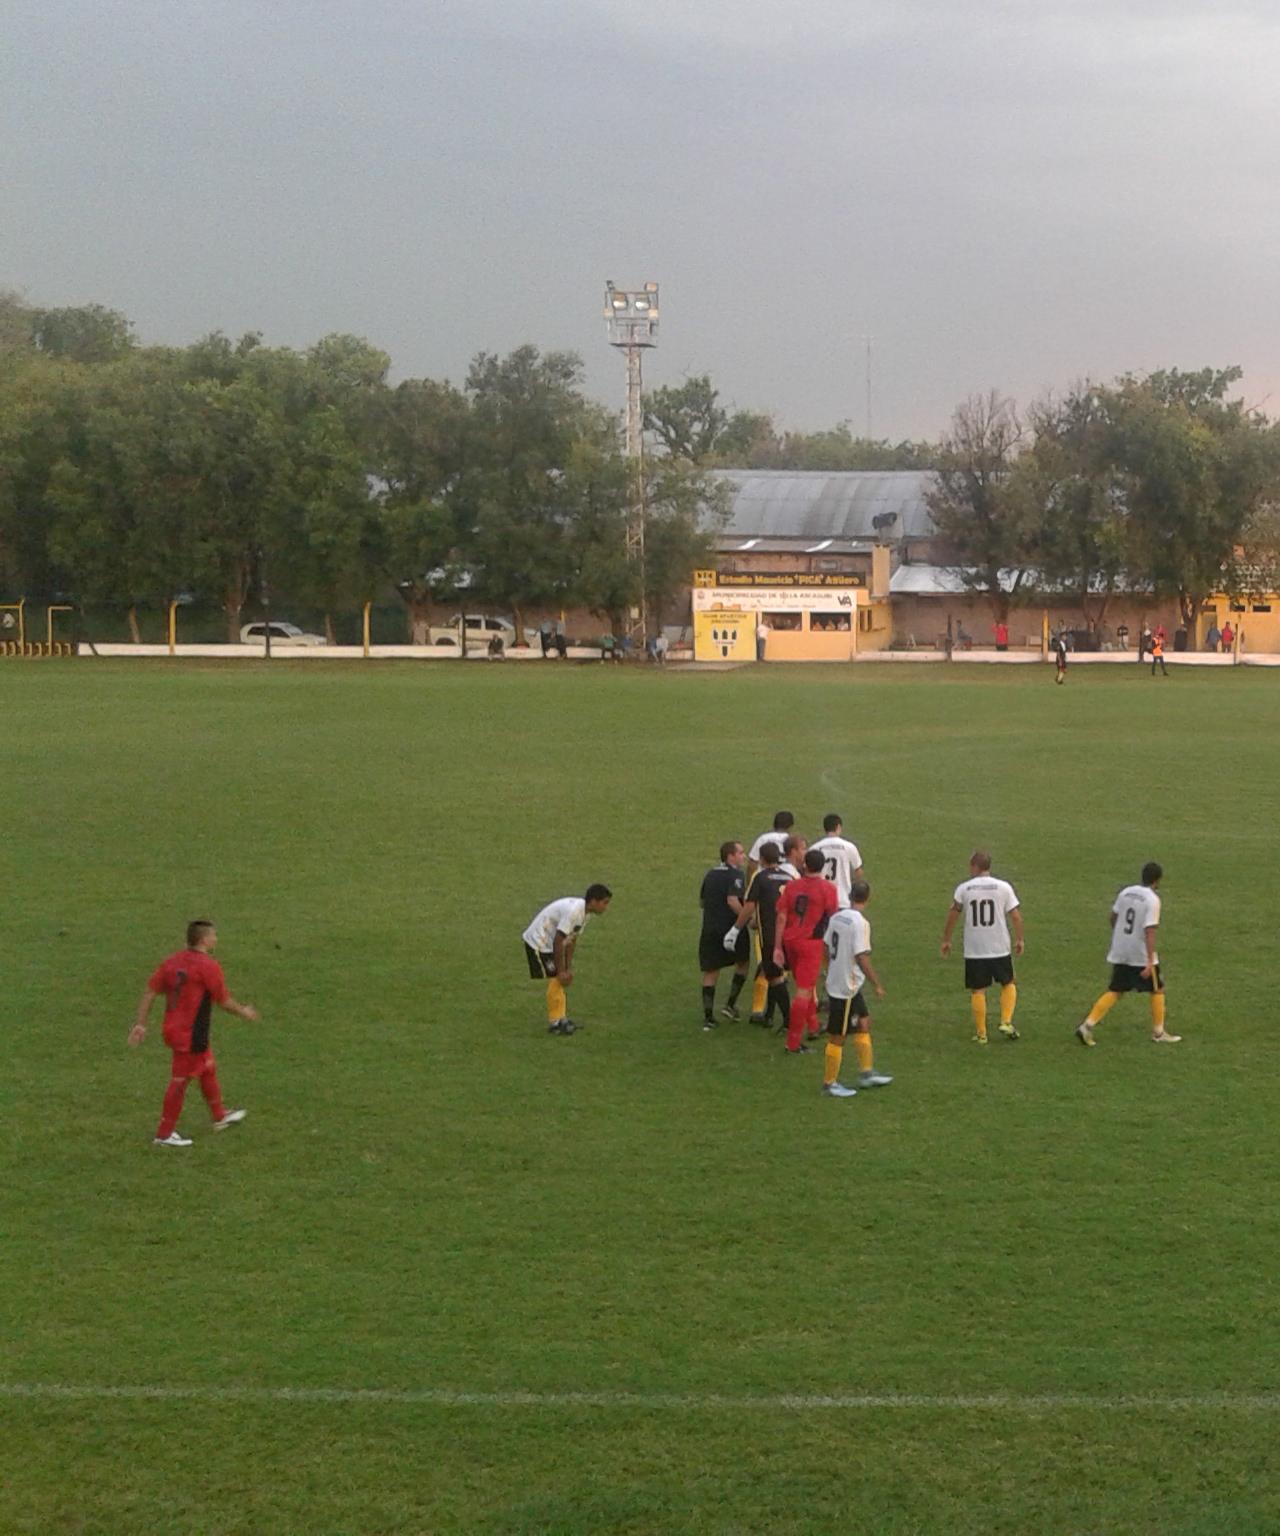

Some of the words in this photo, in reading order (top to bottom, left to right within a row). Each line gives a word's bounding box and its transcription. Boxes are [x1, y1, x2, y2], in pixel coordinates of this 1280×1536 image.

[824, 857, 838, 881] 3
[794, 894, 809, 928] 9
[969, 898, 995, 927] 10
[1123, 907, 1136, 935] 9
[830, 931, 839, 961] 9
